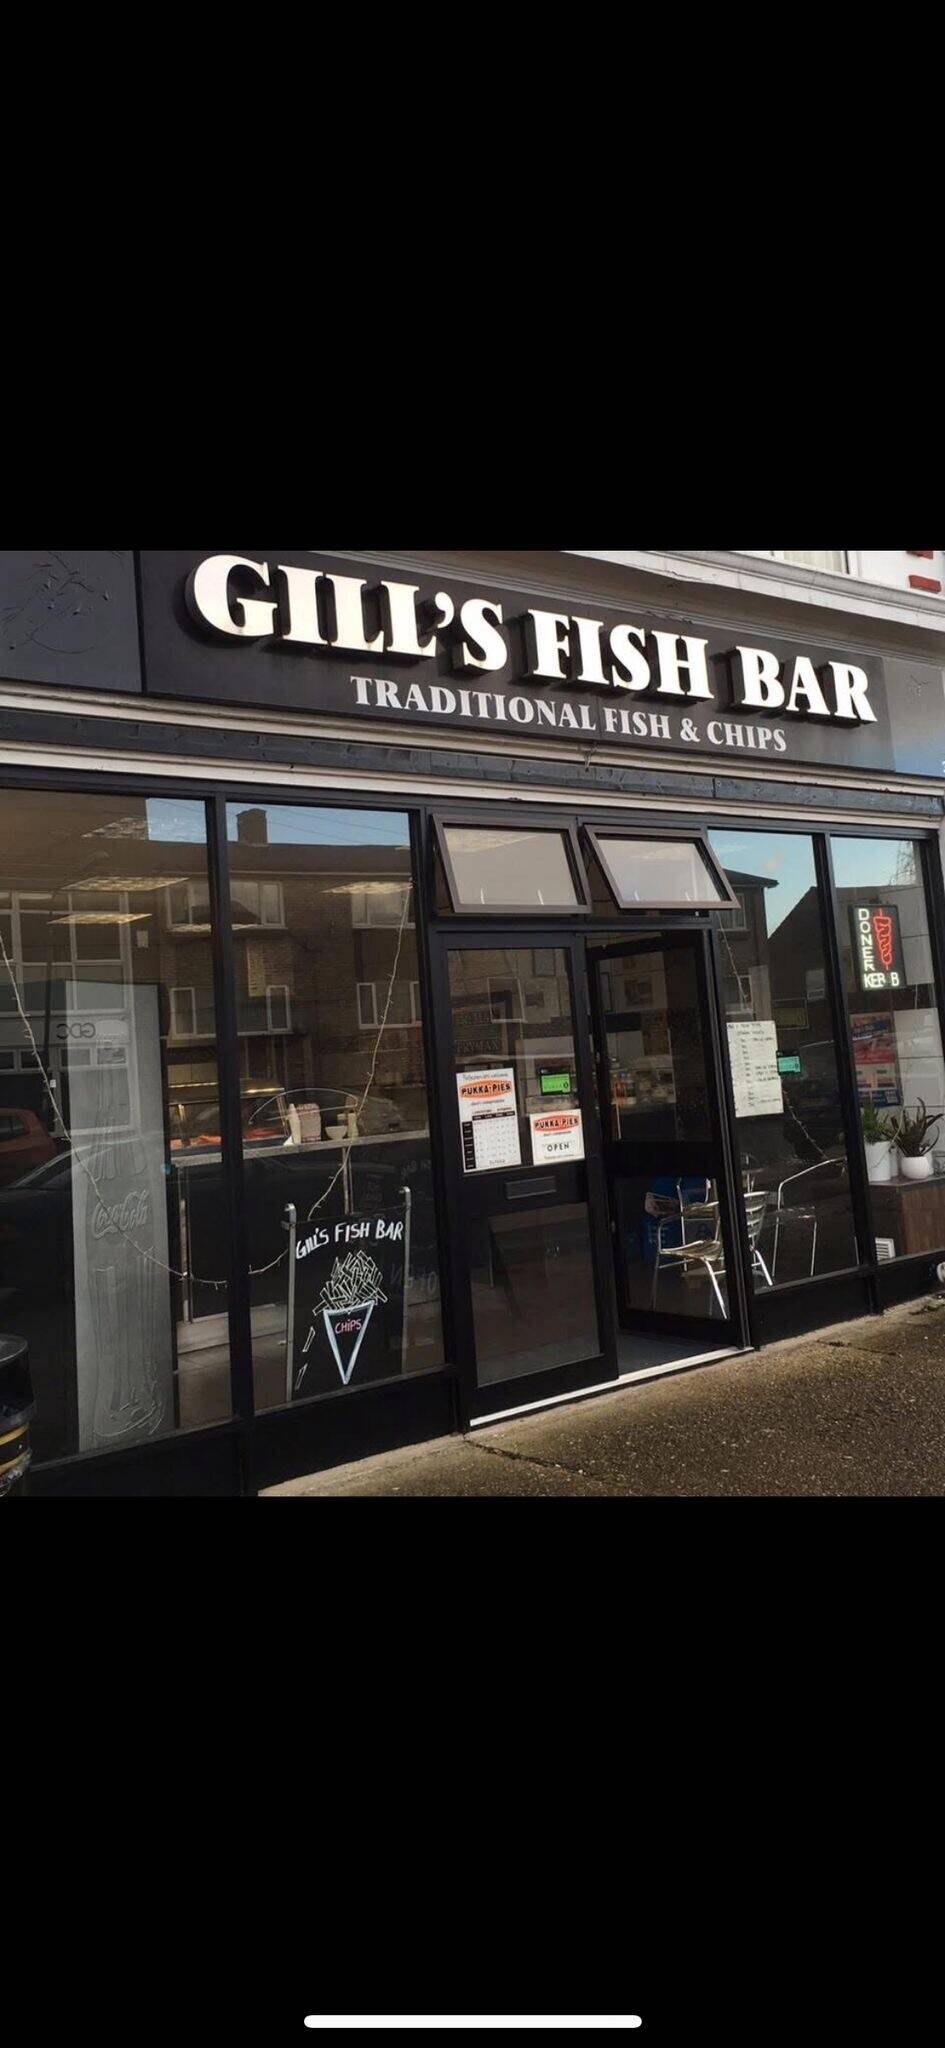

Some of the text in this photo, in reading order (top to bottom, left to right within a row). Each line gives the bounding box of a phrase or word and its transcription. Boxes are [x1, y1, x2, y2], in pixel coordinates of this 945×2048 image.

[192, 554, 877, 722] GILL’S FISH BAR
[350, 675, 787, 752] TRADITIONAL FISH & CHIPS
[858, 908, 876, 971] DONER
[547, 1143, 570, 1152] OPEN
[335, 1221, 370, 1242] FISH
[375, 1219, 404, 1241] BAR
